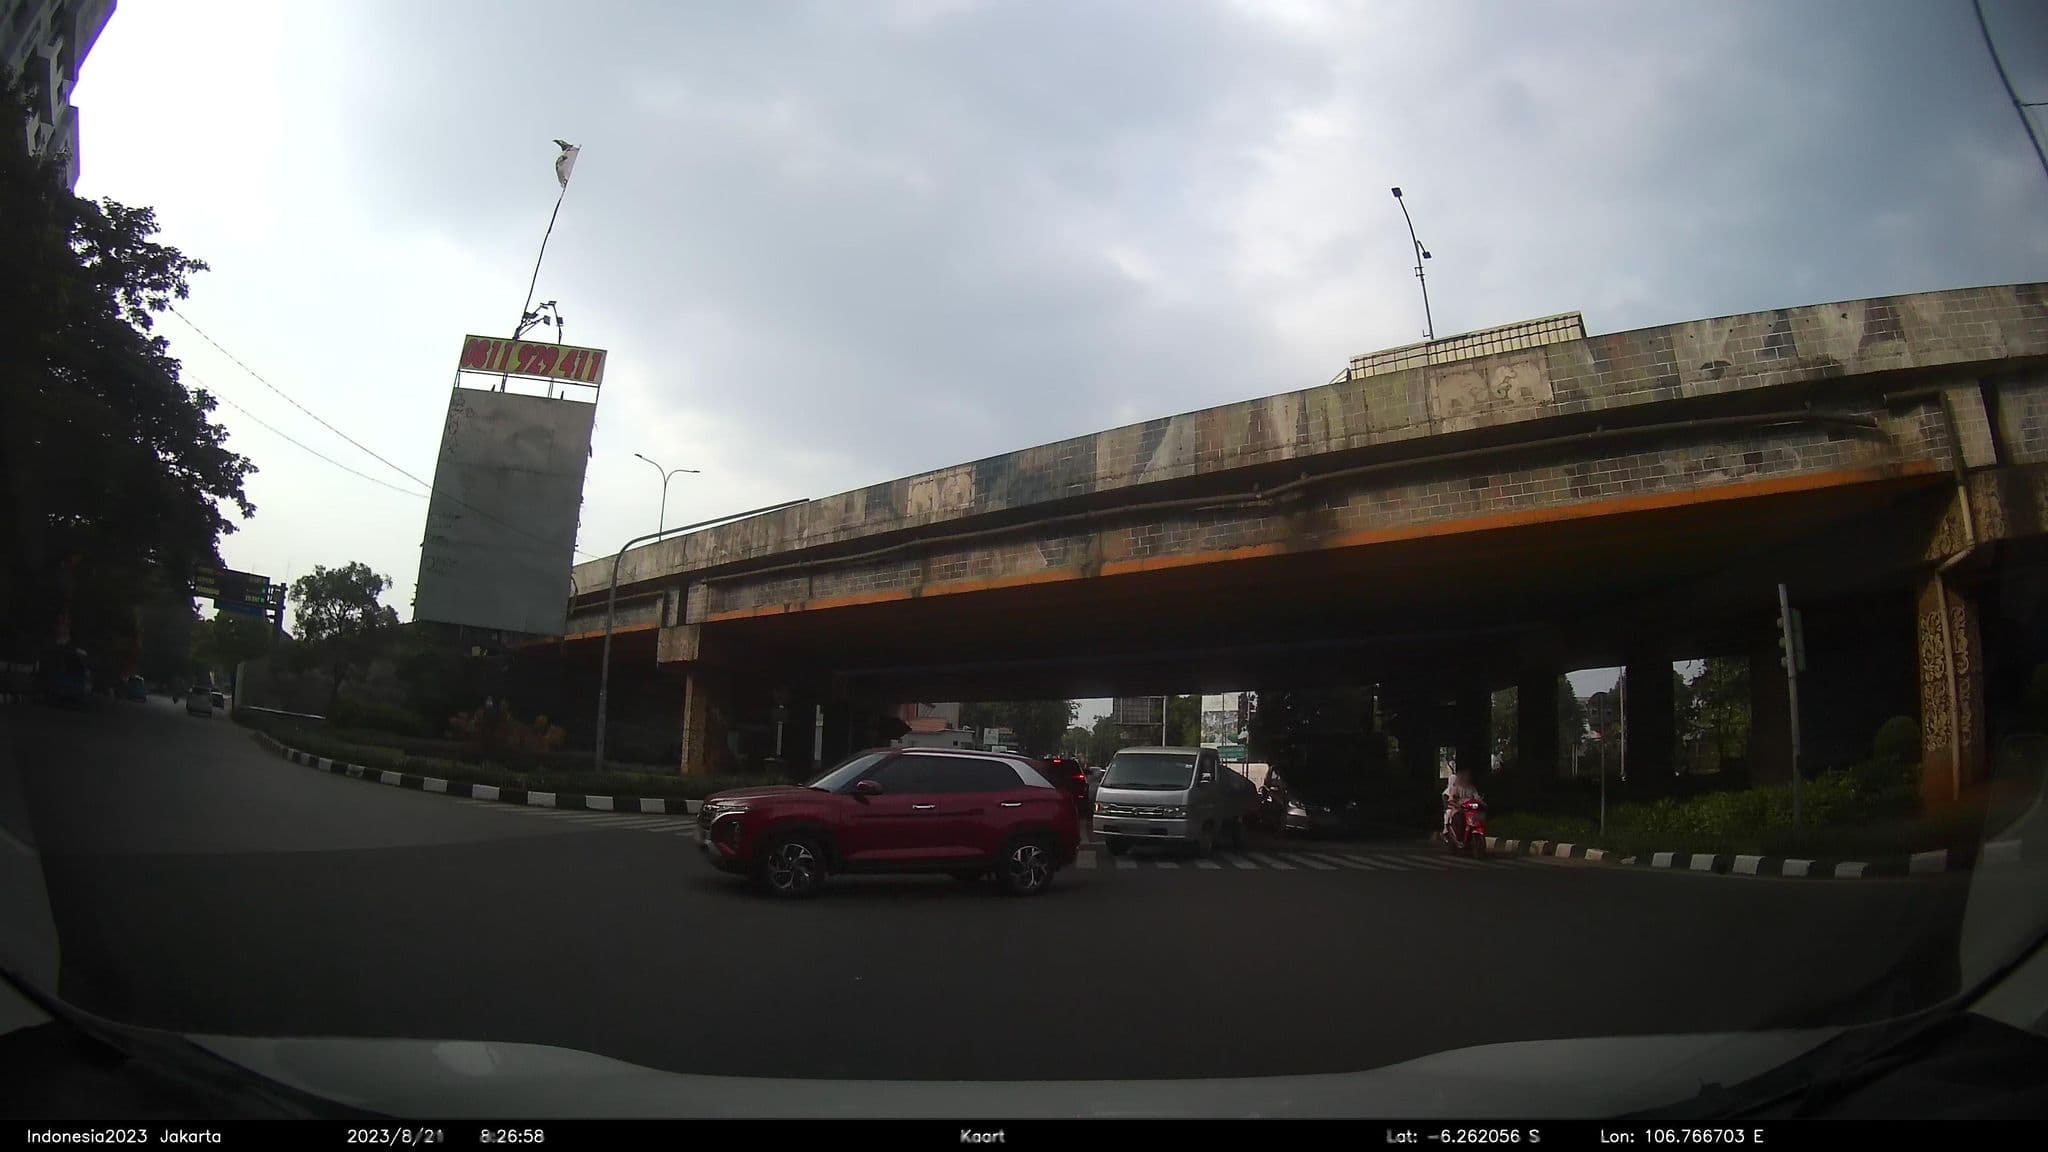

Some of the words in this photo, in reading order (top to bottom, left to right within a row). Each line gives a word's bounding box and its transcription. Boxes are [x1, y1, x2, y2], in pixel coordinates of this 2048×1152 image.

[461, 339, 515, 369] 0811
[515, 344, 560, 376] 929
[559, 349, 603, 382] 411
